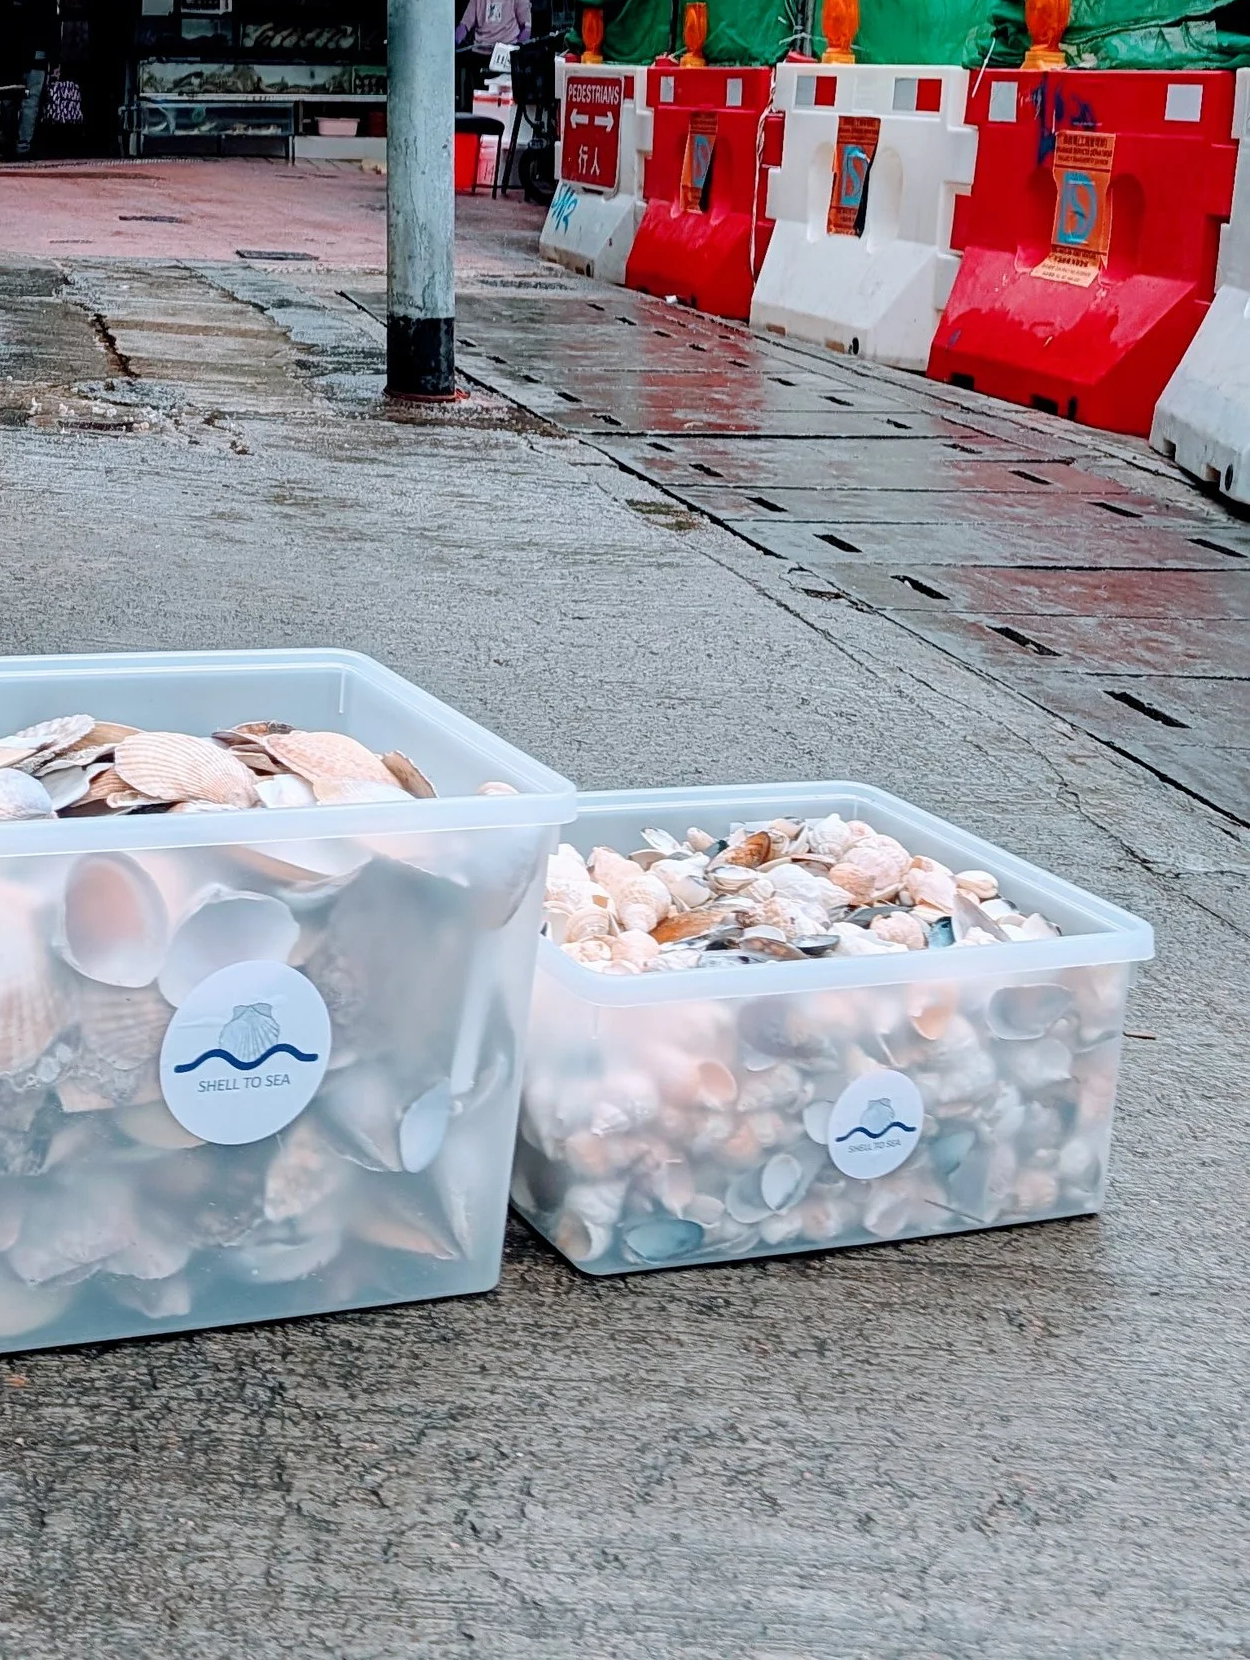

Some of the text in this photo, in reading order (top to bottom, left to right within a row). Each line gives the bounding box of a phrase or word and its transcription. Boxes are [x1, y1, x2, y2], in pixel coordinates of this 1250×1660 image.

[568, 83, 619, 105] PEDESTRIANS
[578, 143, 600, 176] 行人
[197, 1074, 290, 1092] SHELL TO SEA
